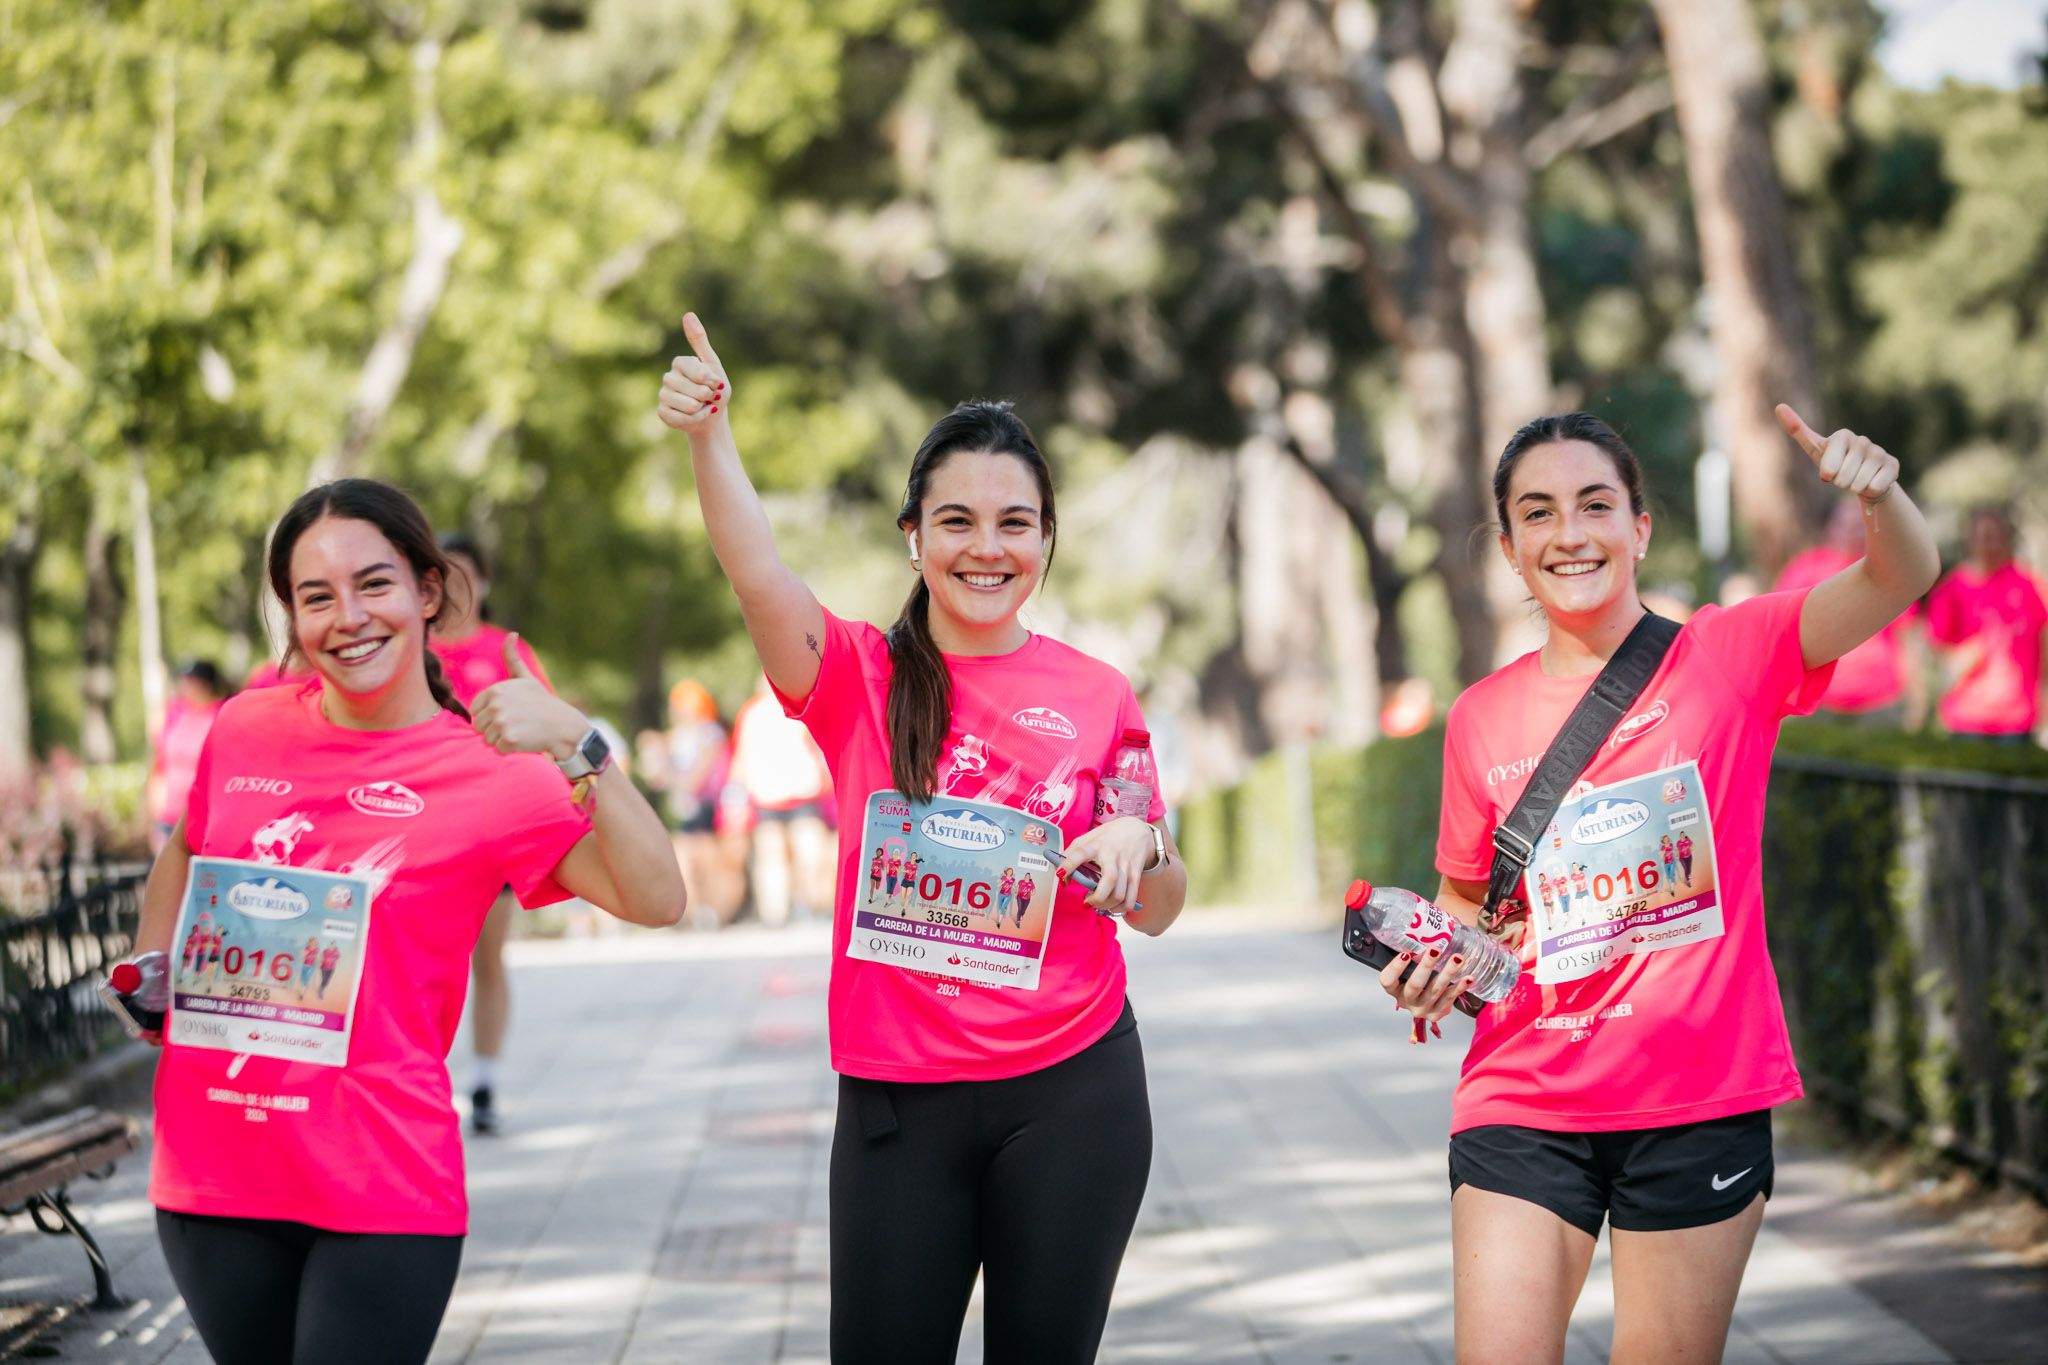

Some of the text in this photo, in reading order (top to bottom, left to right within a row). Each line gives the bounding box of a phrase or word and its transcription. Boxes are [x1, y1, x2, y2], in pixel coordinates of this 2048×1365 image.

[1019, 715, 1073, 735] ASTURIANA
[224, 776, 293, 796] OYSHO
[878, 805, 911, 817] SUMA
[926, 819, 1000, 846] ASTURIANA
[1027, 825, 1045, 838] 20
[1576, 811, 1646, 839] ASTURIANA
[918, 873, 992, 909] 016
[1592, 860, 1660, 902] 016
[233, 889, 305, 914] ASTURIANA
[1606, 899, 1648, 921] 34792
[926, 910, 969, 928] 33568
[1557, 929, 1597, 948] CARRERA
[1598, 927, 1612, 938] DE
[1614, 922, 1625, 933] LA
[1627, 913, 1657, 929] MUJER
[1662, 899, 1698, 919] MADRID
[874, 917, 913, 934] CARRERA
[915, 925, 928, 936] DE
[930, 927, 941, 939] LA
[943, 929, 976, 945] MUJER
[983, 936, 1022, 952] MADRID
[1647, 921, 1703, 943] Santander
[869, 937, 926, 960] OYSHO
[1557, 945, 1615, 972] OYSHO
[223, 945, 295, 982] 016
[962, 956, 1021, 976] Santander
[229, 984, 271, 1001] 34793
[935, 982, 961, 998] 2024
[185, 997, 218, 1012] CARRERA
[219, 1000, 231, 1012] DE
[232, 1002, 243, 1013] LA
[245, 1004, 277, 1017] MUJER
[284, 1009, 325, 1026] MADRID
[183, 1019, 229, 1037] OYSHO
[263, 1031, 324, 1049] Santander
[272, 1095, 310, 1112] MUJER
